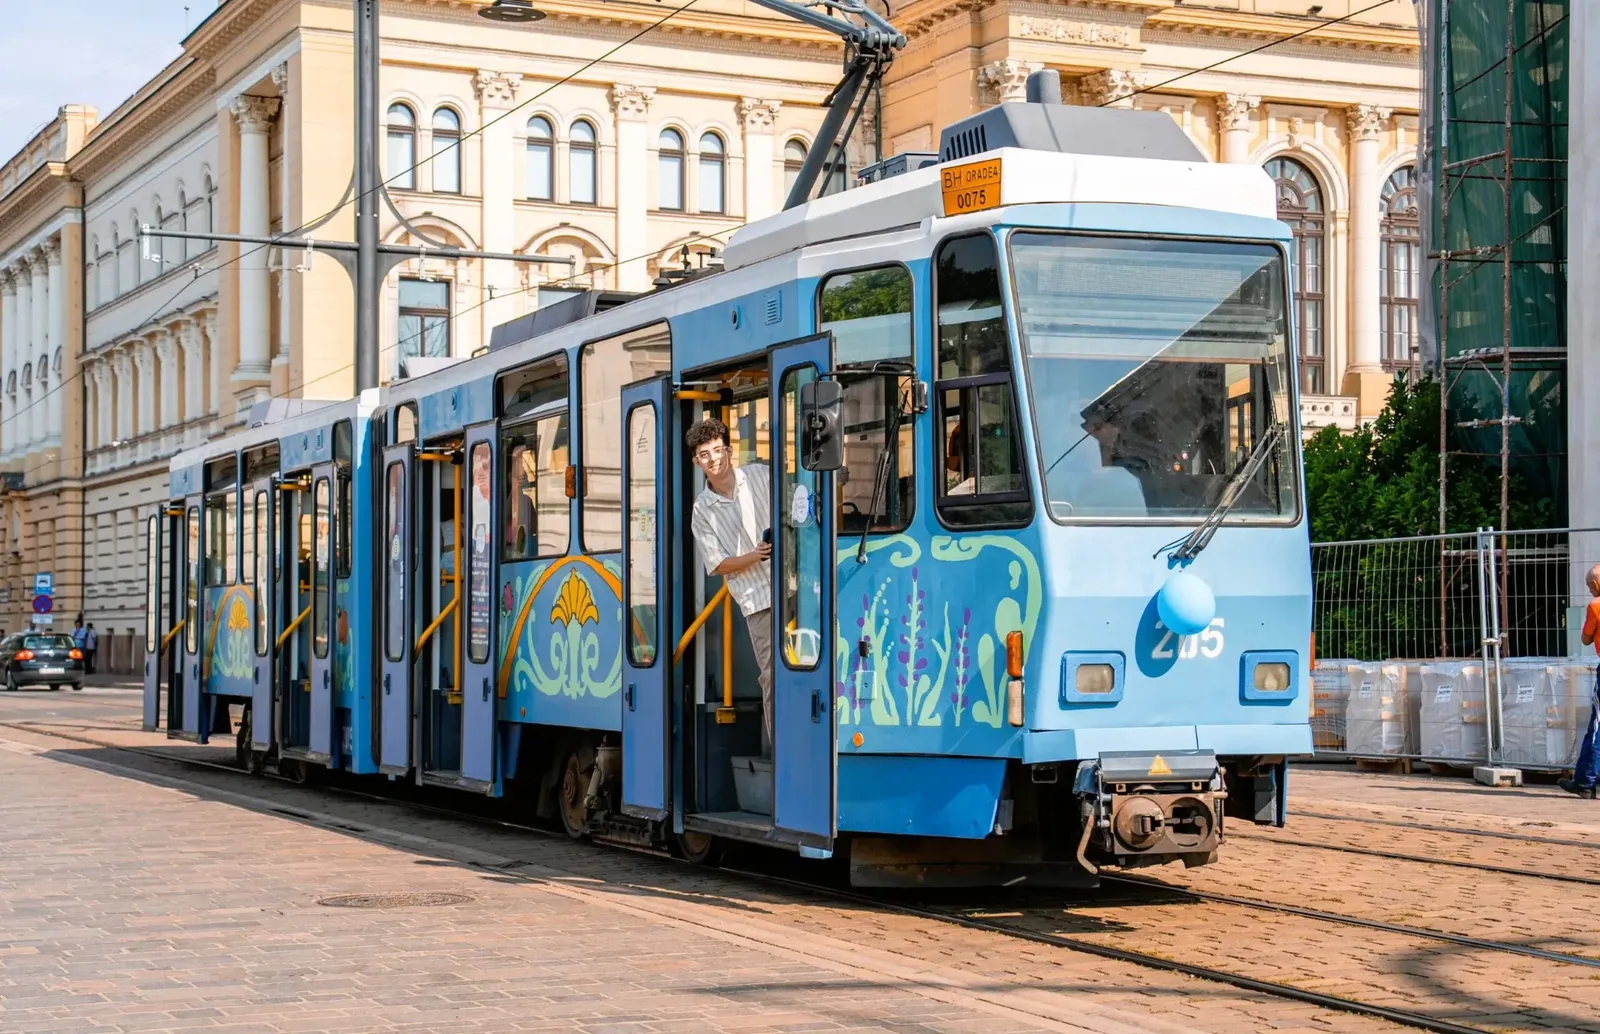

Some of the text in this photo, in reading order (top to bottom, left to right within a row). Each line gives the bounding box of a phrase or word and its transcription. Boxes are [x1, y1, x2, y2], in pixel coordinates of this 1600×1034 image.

[944, 166, 998, 188] BH ORADEA
[957, 189, 986, 208] 0075
